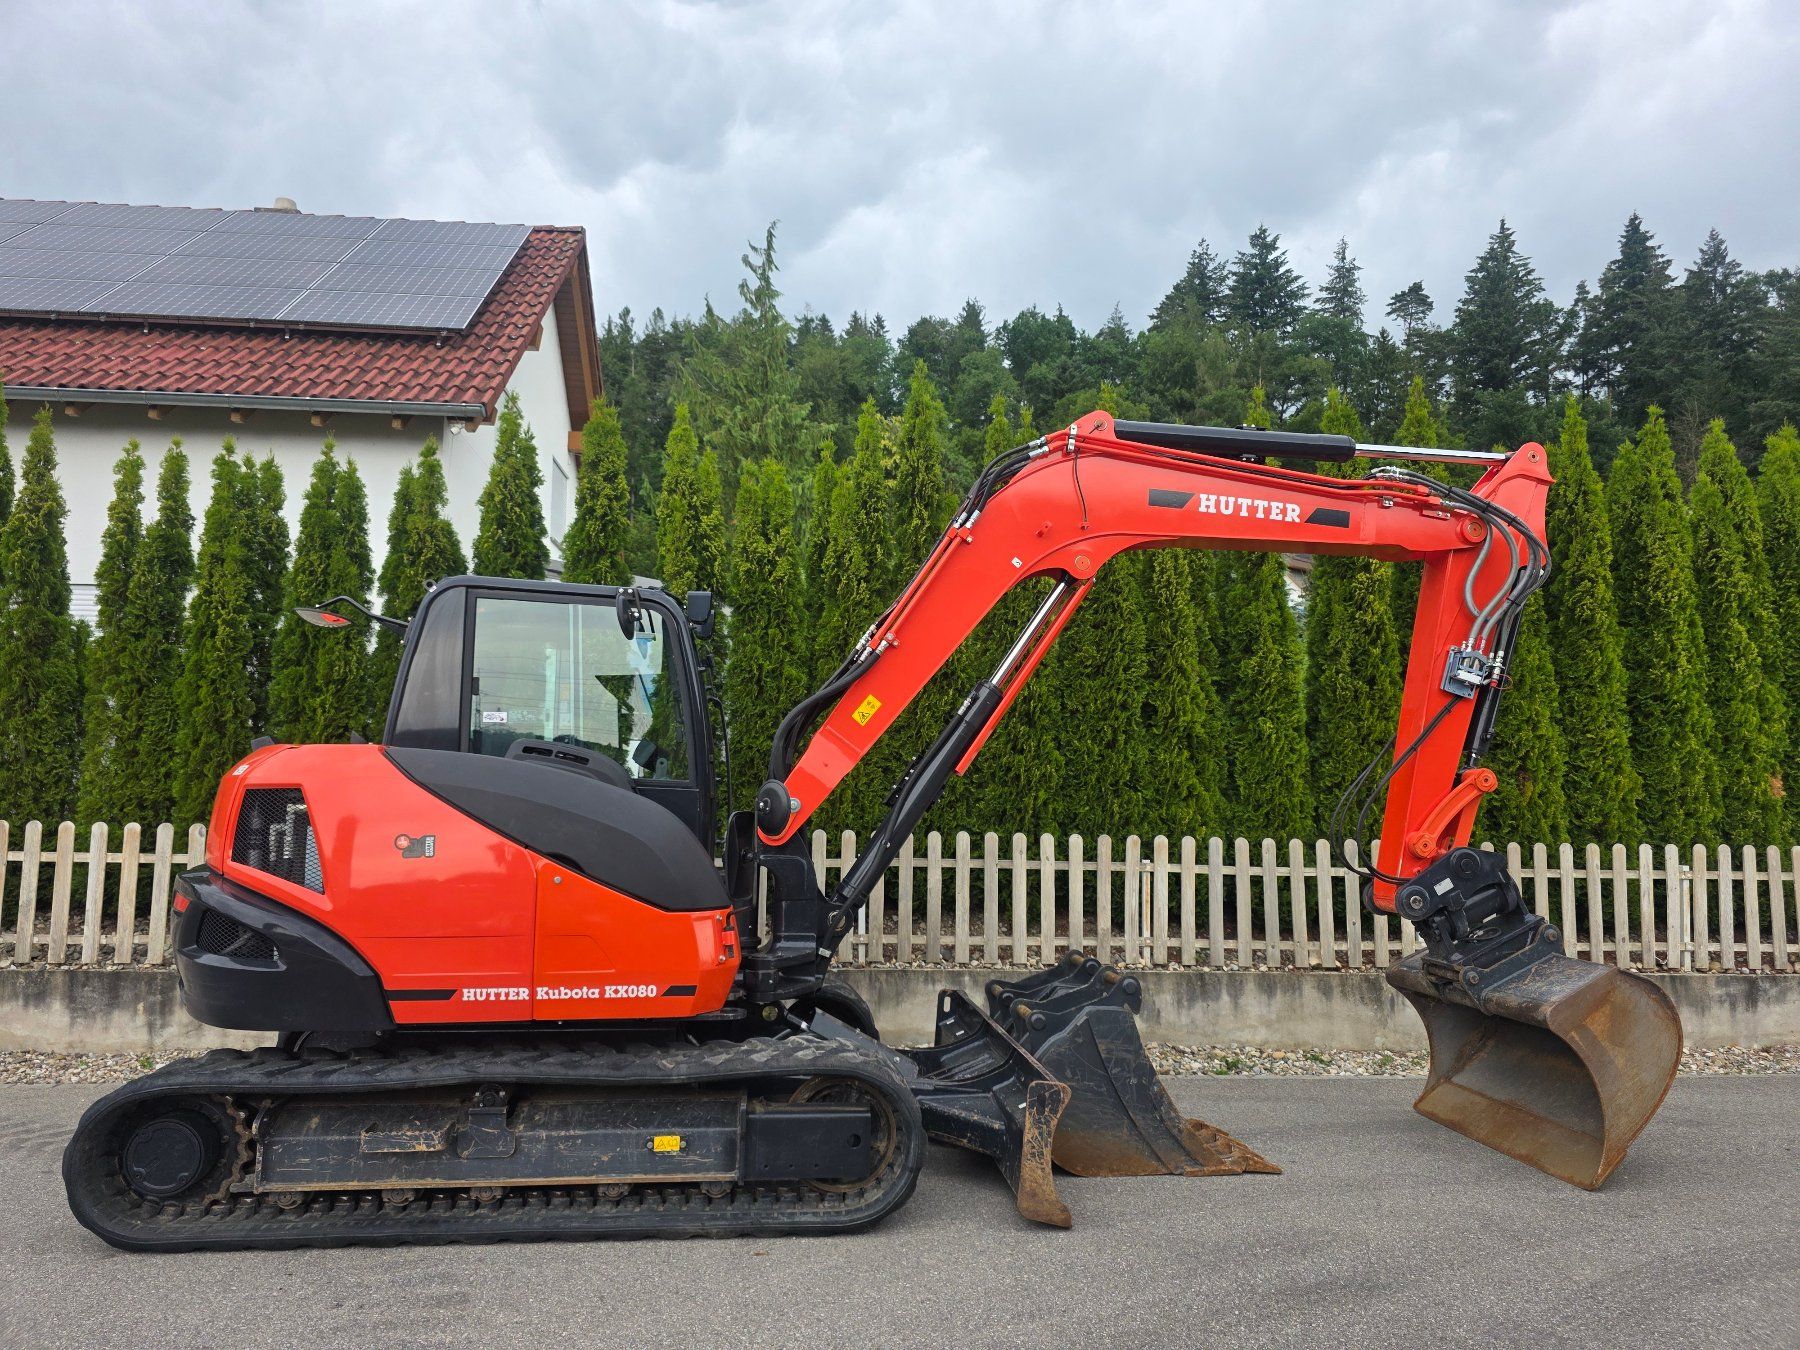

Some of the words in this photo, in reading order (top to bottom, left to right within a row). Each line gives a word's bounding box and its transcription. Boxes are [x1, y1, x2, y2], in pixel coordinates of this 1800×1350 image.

[1198, 493, 1301, 523] HUTTER
[462, 987, 530, 1001] HUTTER
[535, 986, 600, 1000] Kubota
[604, 984, 657, 998] KX080
